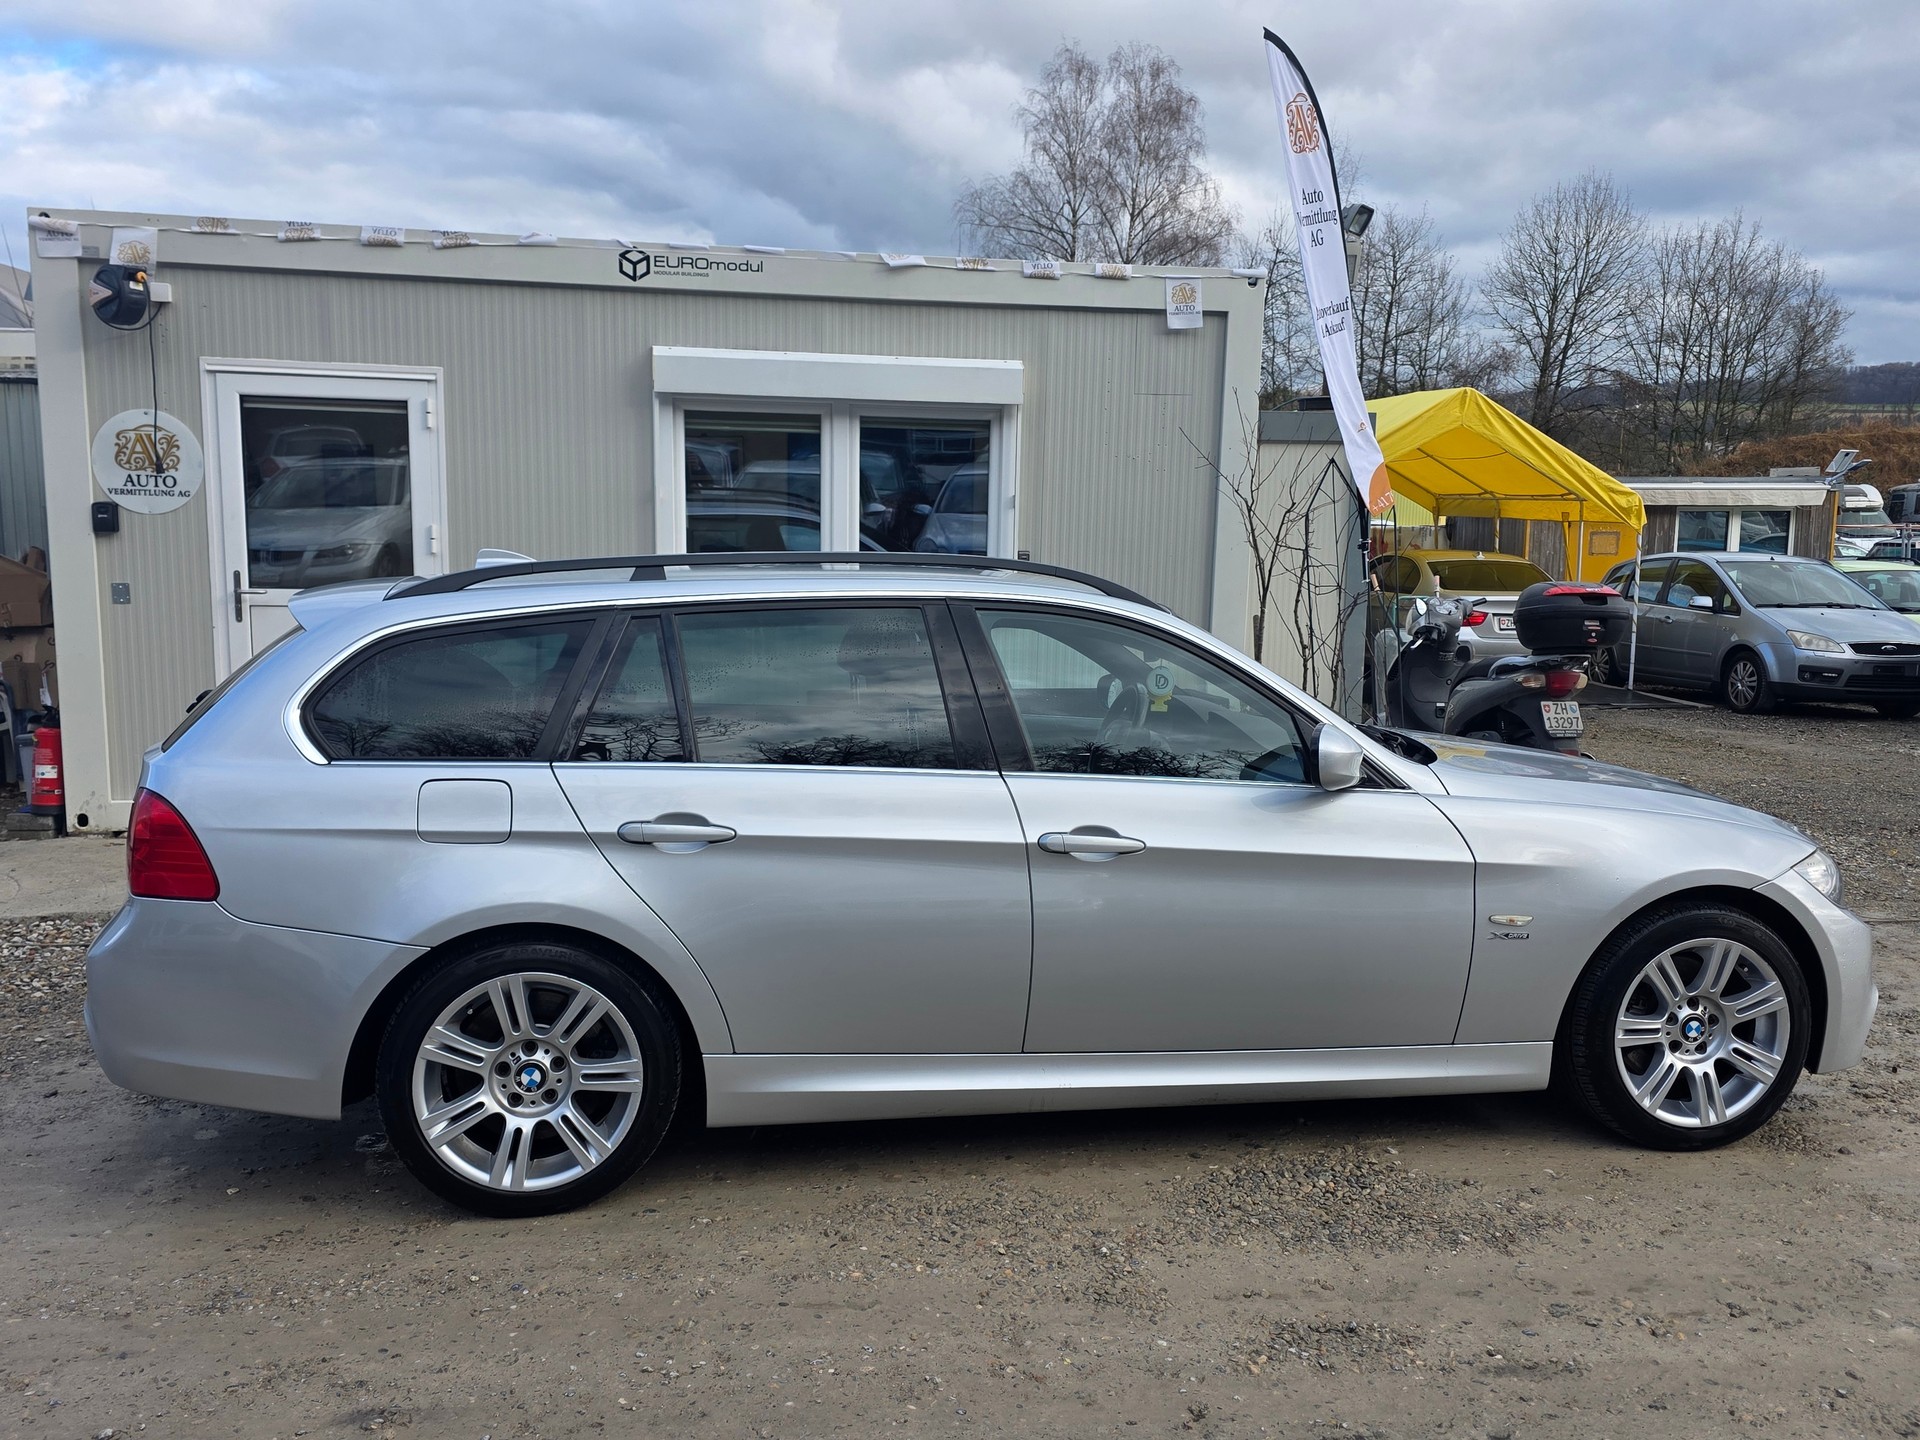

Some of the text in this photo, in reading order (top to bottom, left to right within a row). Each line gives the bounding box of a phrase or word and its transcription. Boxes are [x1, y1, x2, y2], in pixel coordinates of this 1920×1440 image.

[1302, 187, 1324, 206] Auto
[1311, 228, 1324, 248] AG
[654, 256, 763, 273] EUROmodul
[1174, 304, 1196, 312] AUTO
[123, 474, 177, 488] AUTO
[107, 488, 191, 498] VERMITTLUNG AG
[1552, 703, 1569, 715] ZH
[1546, 716, 1580, 729] 13297
